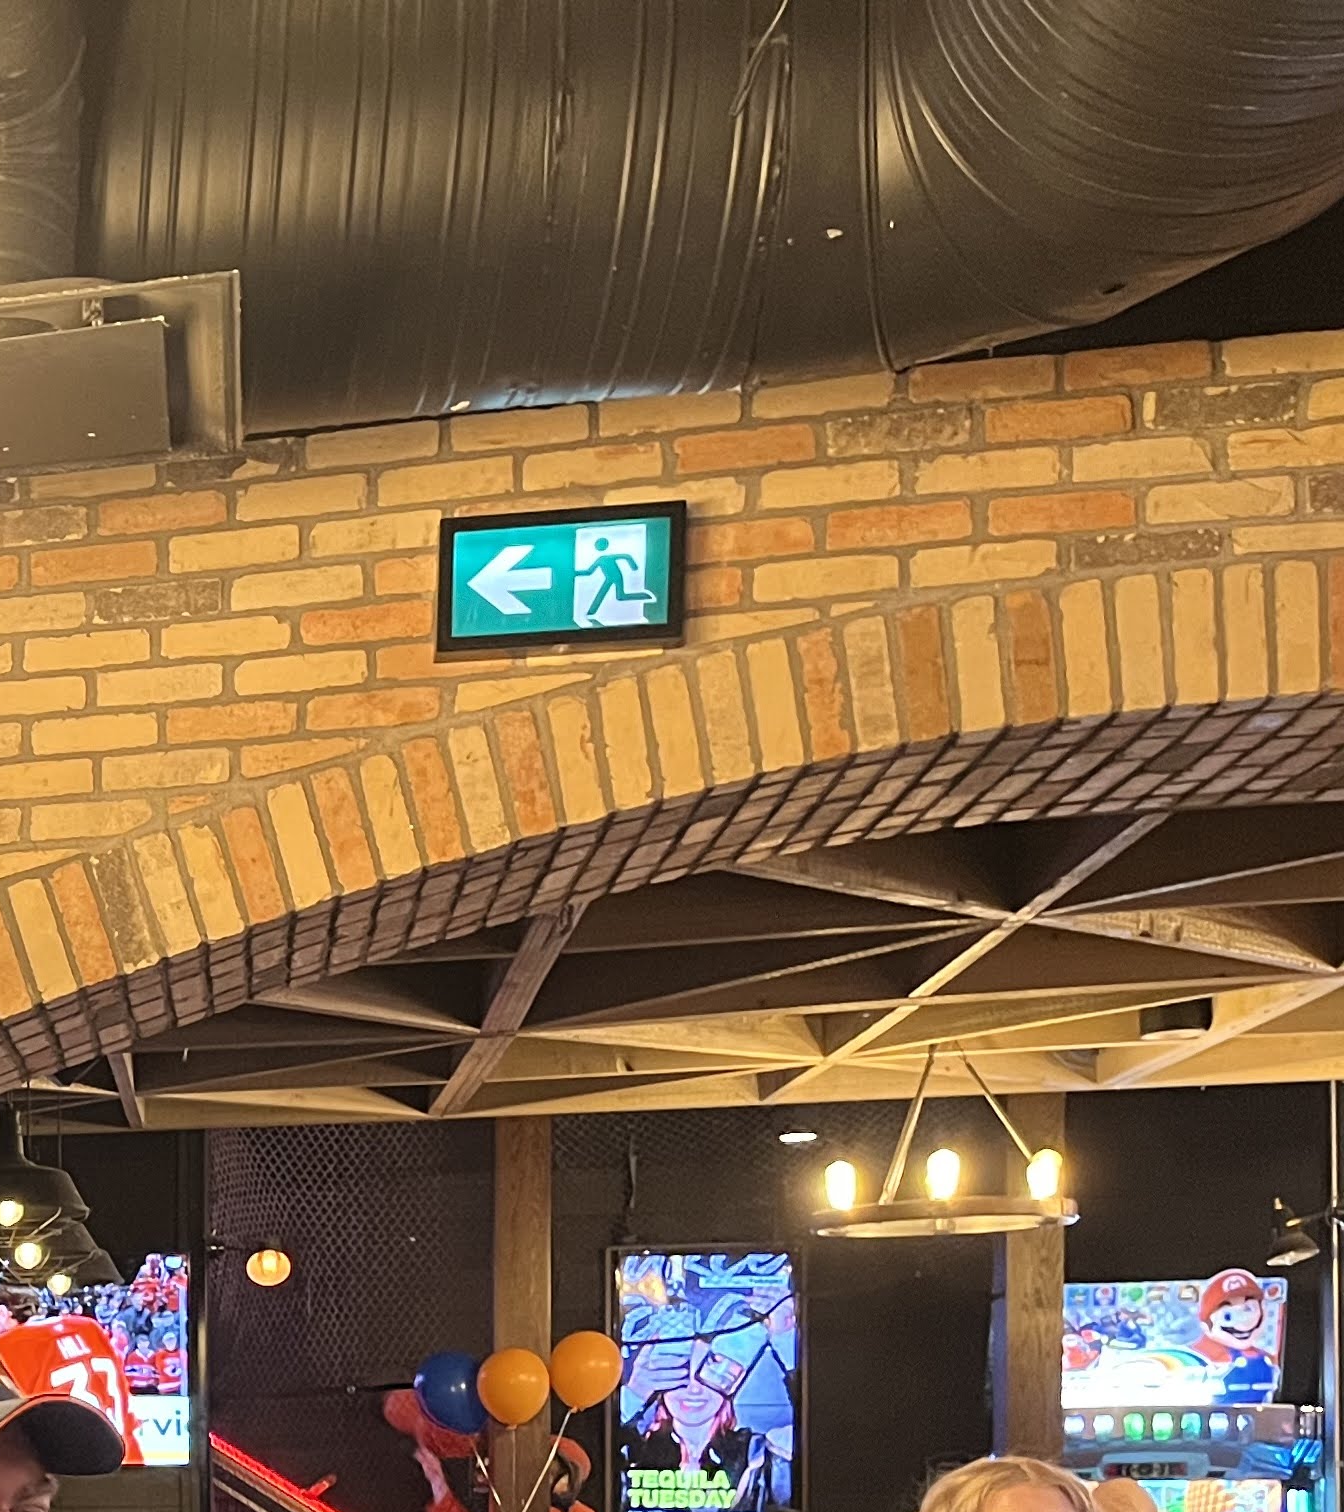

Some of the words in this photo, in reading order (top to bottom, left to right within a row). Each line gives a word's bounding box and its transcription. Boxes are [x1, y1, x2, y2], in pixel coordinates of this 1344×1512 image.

[137, 1410, 190, 1437] rvi
[627, 1469, 731, 1489] TEQUILA
[627, 1488, 737, 1509] TUESDAY
